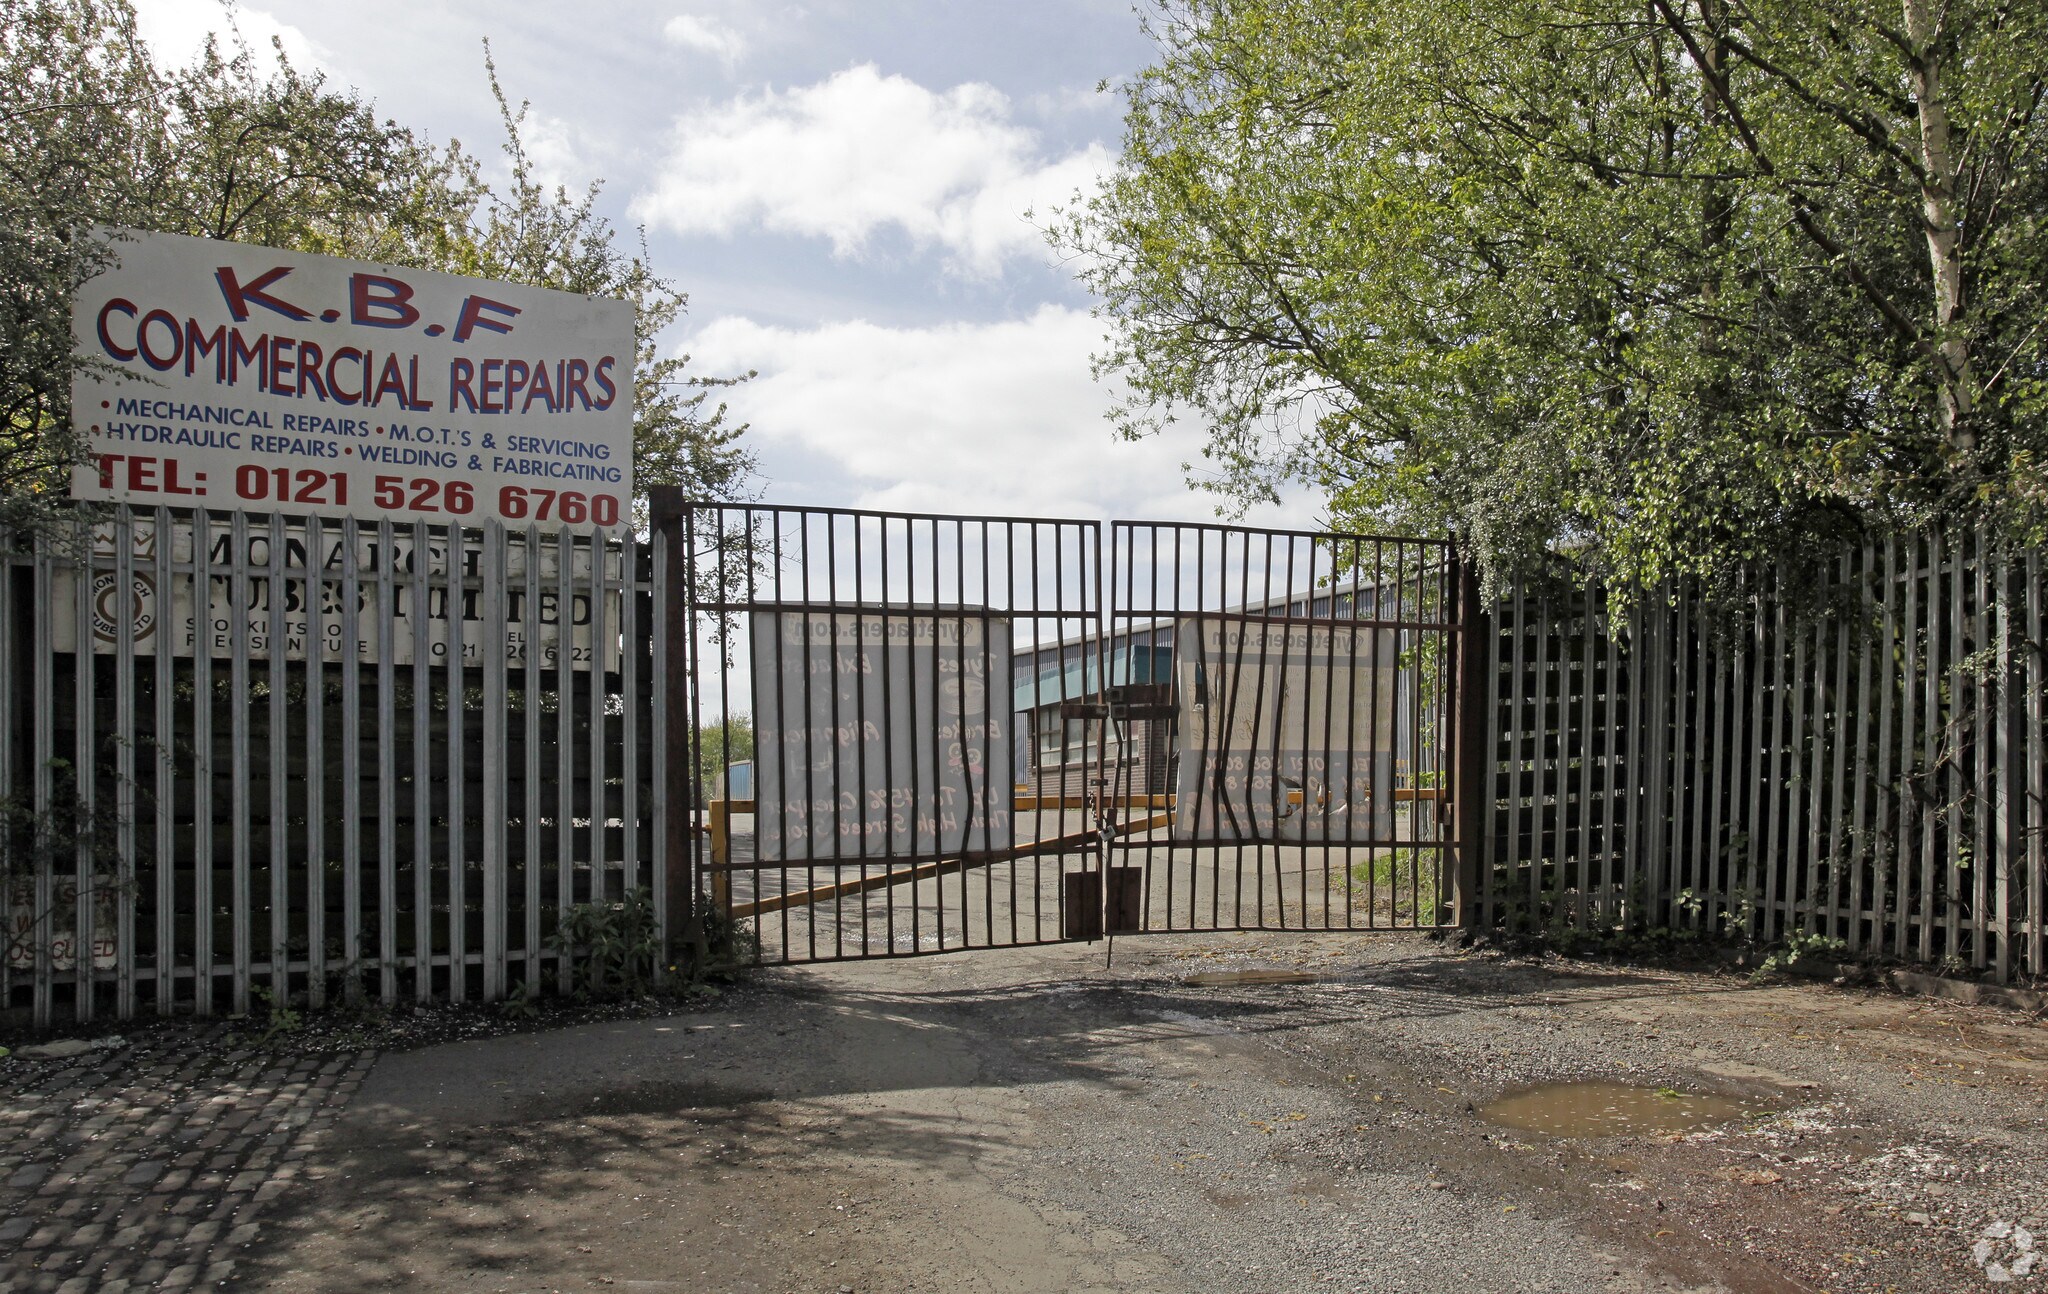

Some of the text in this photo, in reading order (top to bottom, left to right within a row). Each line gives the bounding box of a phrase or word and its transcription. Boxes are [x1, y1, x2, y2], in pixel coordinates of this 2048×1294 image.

[214, 266, 522, 343] K.B.F
[97, 298, 617, 414] COMMERCIAL REPAIRS
[116, 399, 369, 437] MECHANICAL REPAIRS
[106, 422, 338, 457] HYDRAULIC REPAIRS
[481, 433, 496, 449] &
[507, 435, 611, 460] SERVICING
[358, 444, 622, 483] WELDING & FABRICATING
[88, 453, 619, 527] TEL: 0121 526 6760
[92, 573, 150, 598] MONCH
[92, 612, 124, 636] TUBE
[391, 584, 592, 626] LMTED
[186, 617, 307, 635] SOKITS
